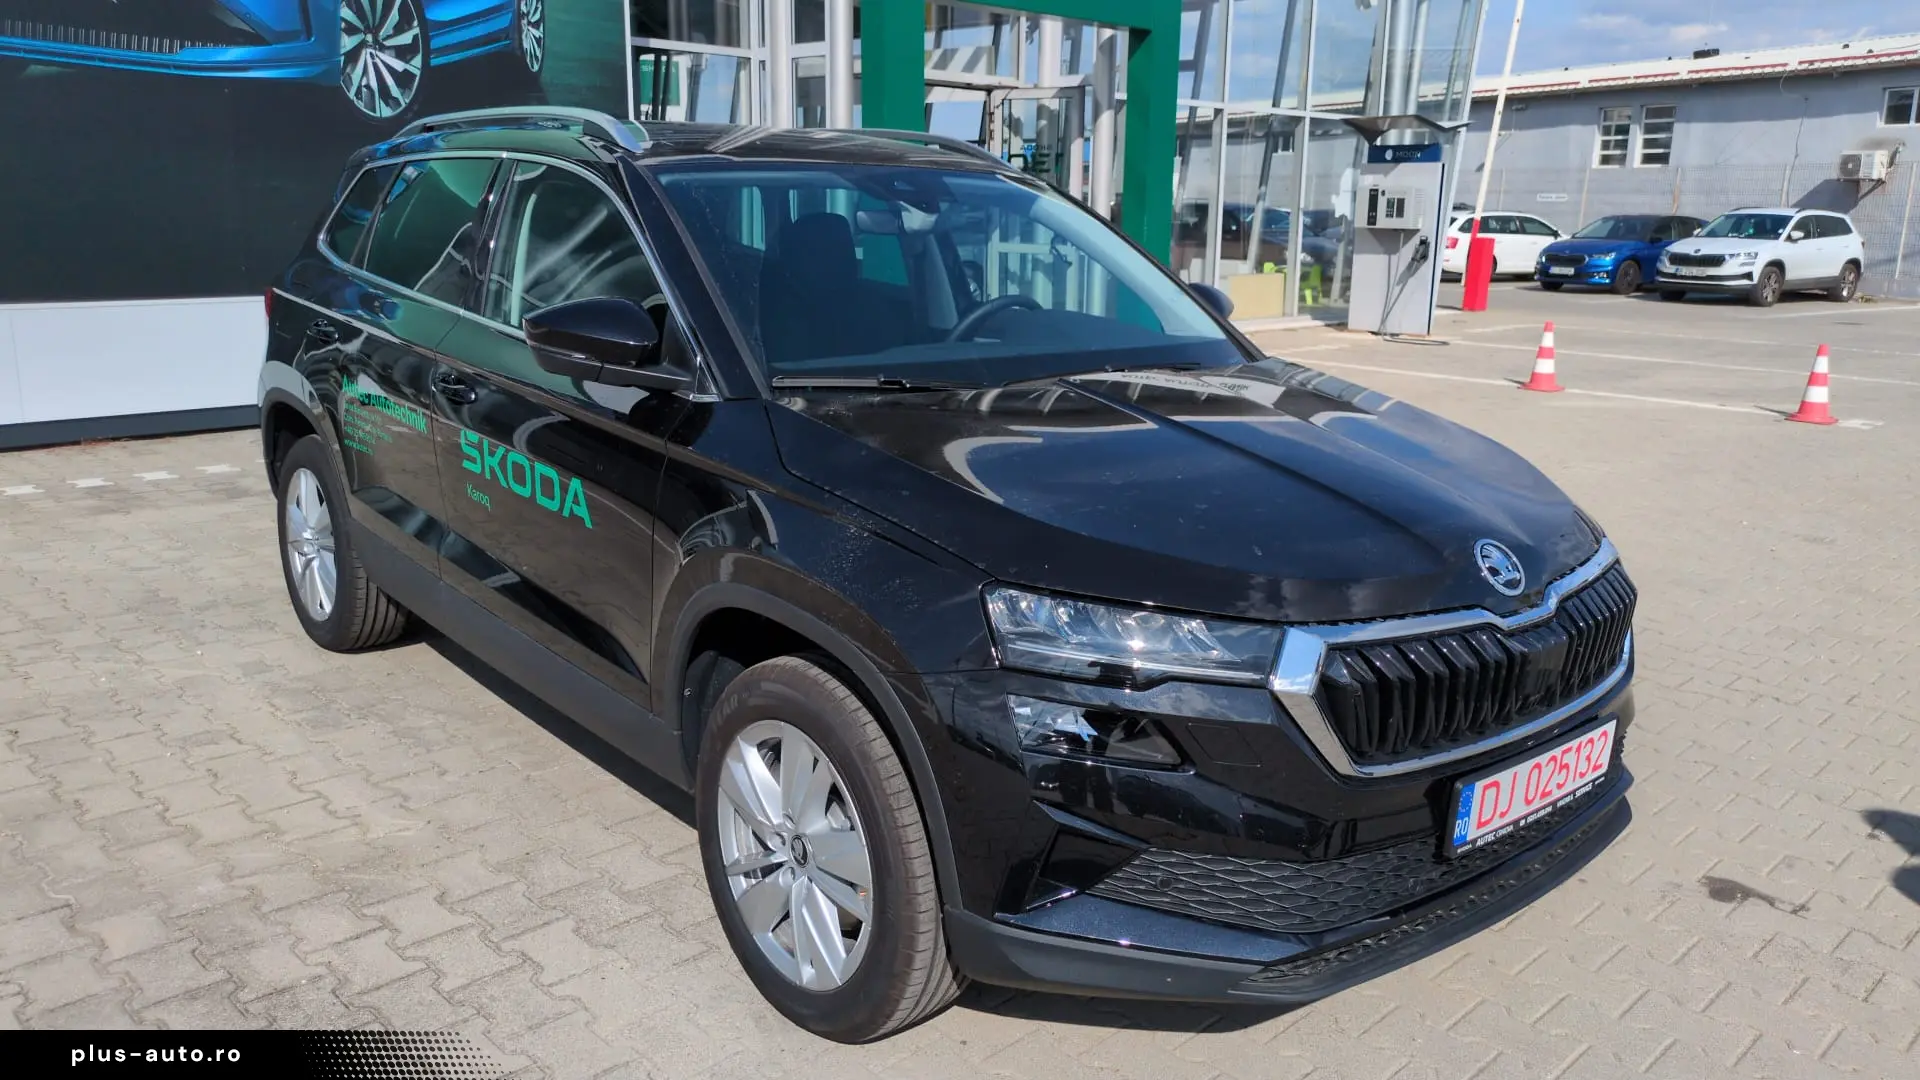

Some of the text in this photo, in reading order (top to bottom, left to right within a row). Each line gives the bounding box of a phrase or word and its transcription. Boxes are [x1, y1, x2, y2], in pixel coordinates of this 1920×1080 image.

[342, 374, 370, 404] Autec
[371, 392, 428, 434] Autotechnik
[466, 482, 491, 512] Karoq
[1476, 729, 1609, 830] DJ 025132
[1454, 817, 1469, 838] RO
